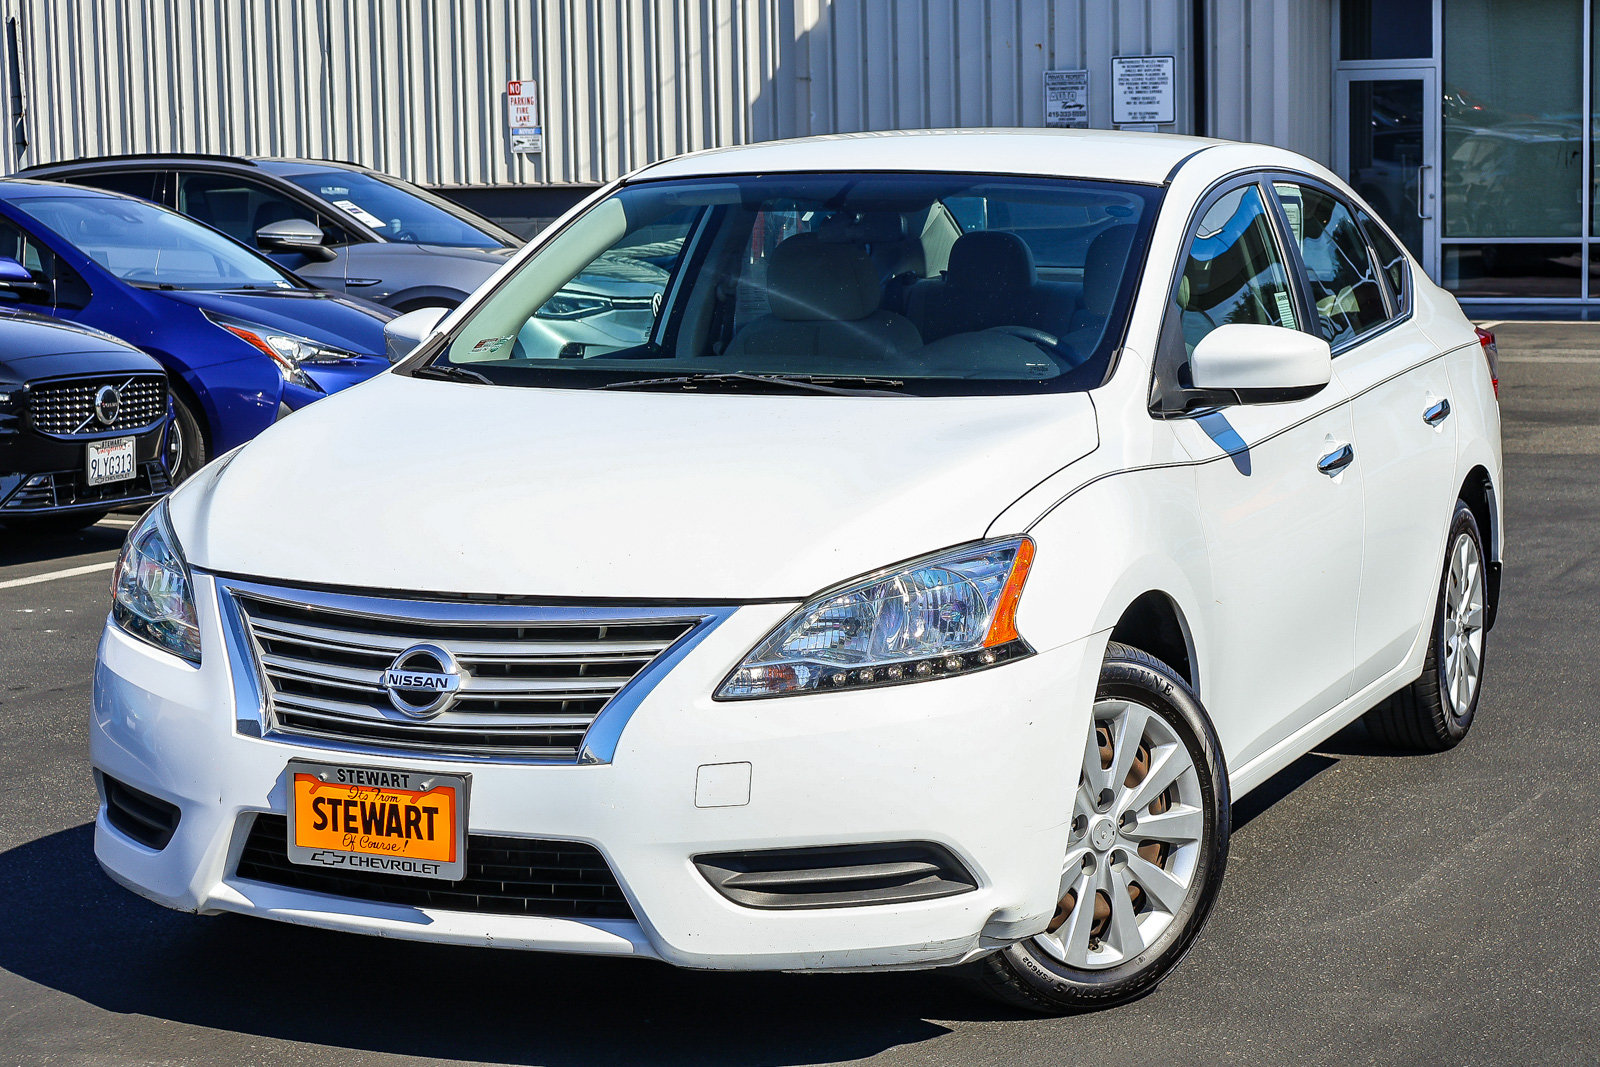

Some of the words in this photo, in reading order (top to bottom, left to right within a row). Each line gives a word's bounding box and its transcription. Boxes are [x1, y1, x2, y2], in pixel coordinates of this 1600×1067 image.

[510, 83, 520, 94] NO
[511, 96, 534, 105] PARKING
[516, 106, 528, 114] FIRE
[102, 439, 122, 448] STEWART
[91, 453, 132, 479] 9LYG313
[388, 673, 449, 689] NISSAN
[337, 768, 410, 789] STEWART
[347, 785, 369, 801] It's
[371, 788, 402, 803] From
[312, 796, 439, 842] STEWART
[342, 833, 357, 852] Of
[350, 856, 440, 874] CHEVROLET
[1022, 956, 1055, 983] FSR602
